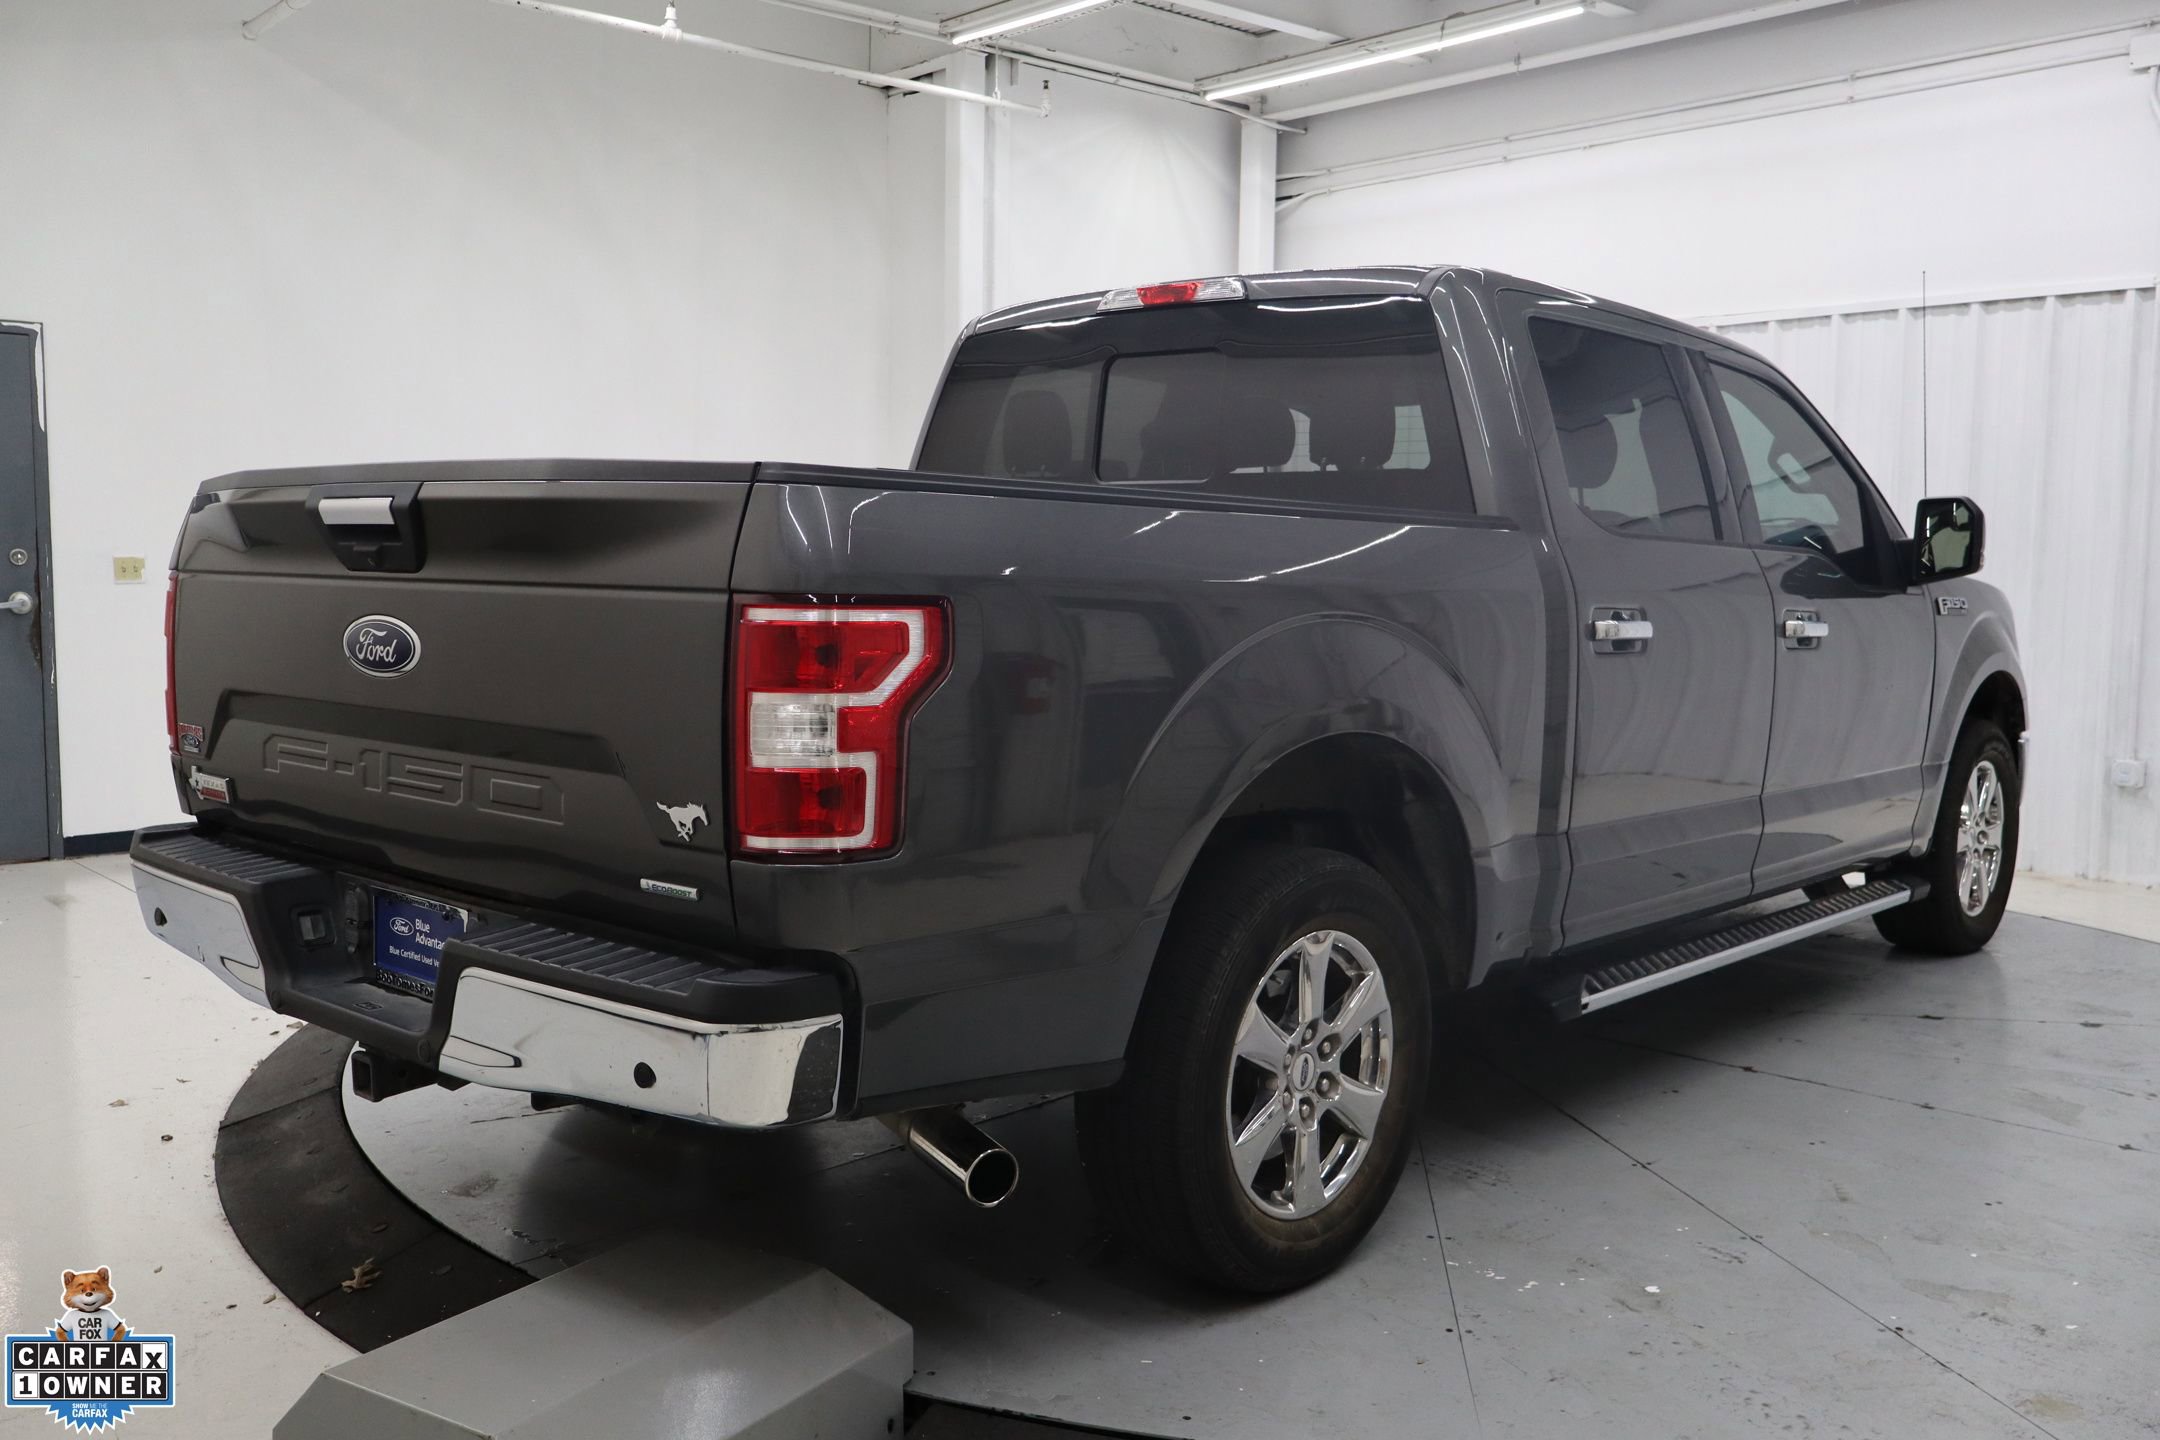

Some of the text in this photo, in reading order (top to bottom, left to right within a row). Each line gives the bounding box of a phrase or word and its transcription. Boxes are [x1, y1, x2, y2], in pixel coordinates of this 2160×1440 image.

[356, 627, 397, 663] Ford
[263, 733, 564, 825] F-150
[393, 919, 410, 933] Ford
[415, 918, 430, 933] Blue
[389, 945, 400, 956] Blue
[400, 949, 421, 962] Certified
[421, 954, 433, 966] Used
[376, 968, 434, 998] BobTomesFor
